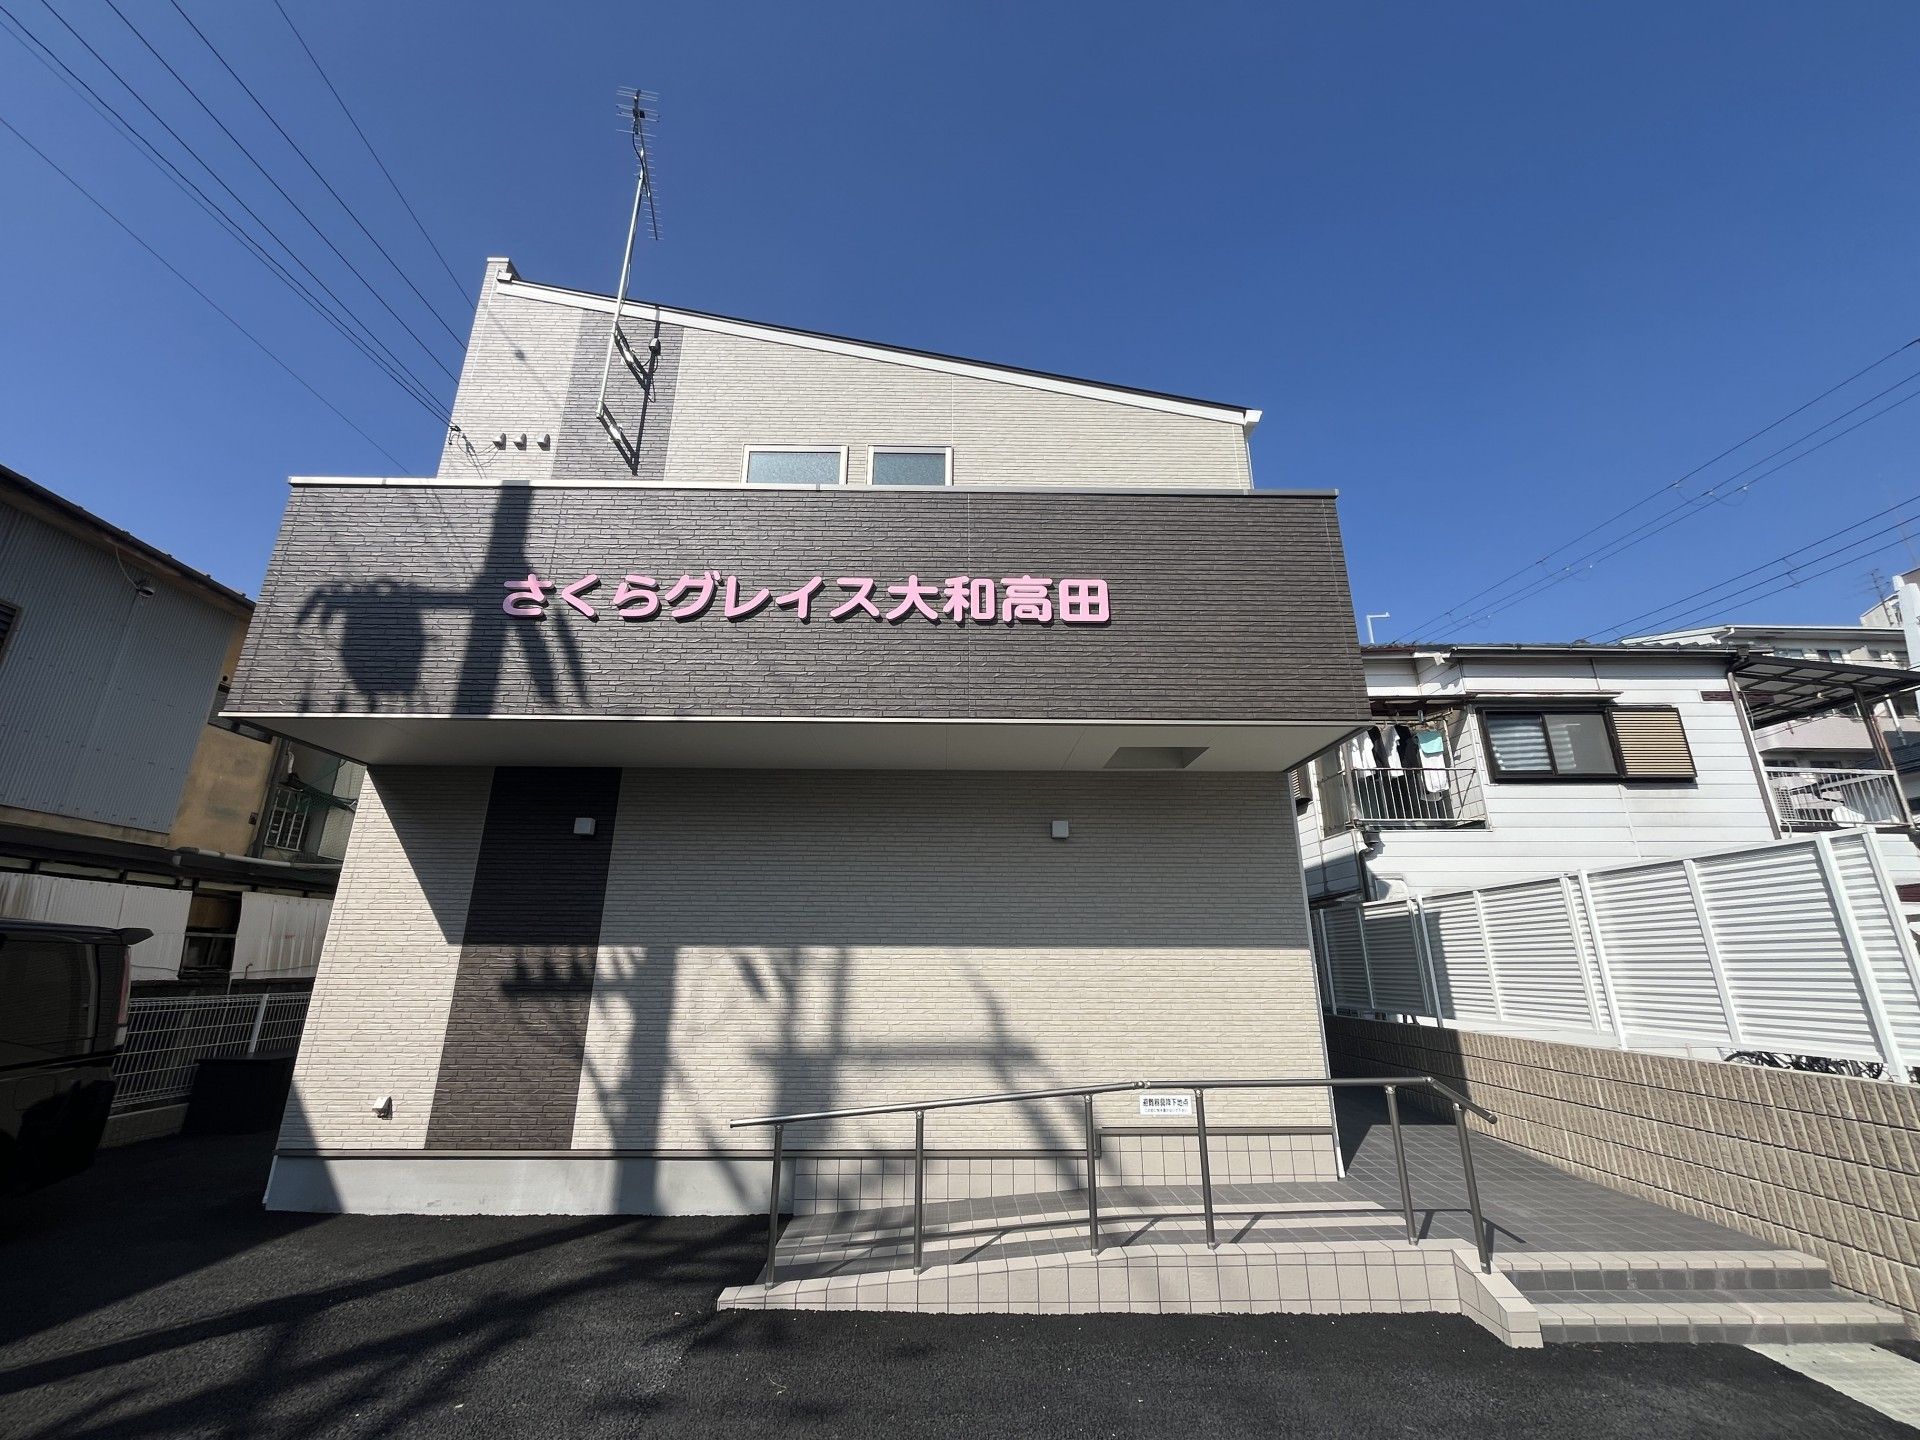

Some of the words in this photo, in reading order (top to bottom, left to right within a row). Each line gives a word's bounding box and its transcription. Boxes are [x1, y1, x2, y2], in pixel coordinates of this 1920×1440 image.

[502, 570, 1111, 624] さくらグレイス大和高田
